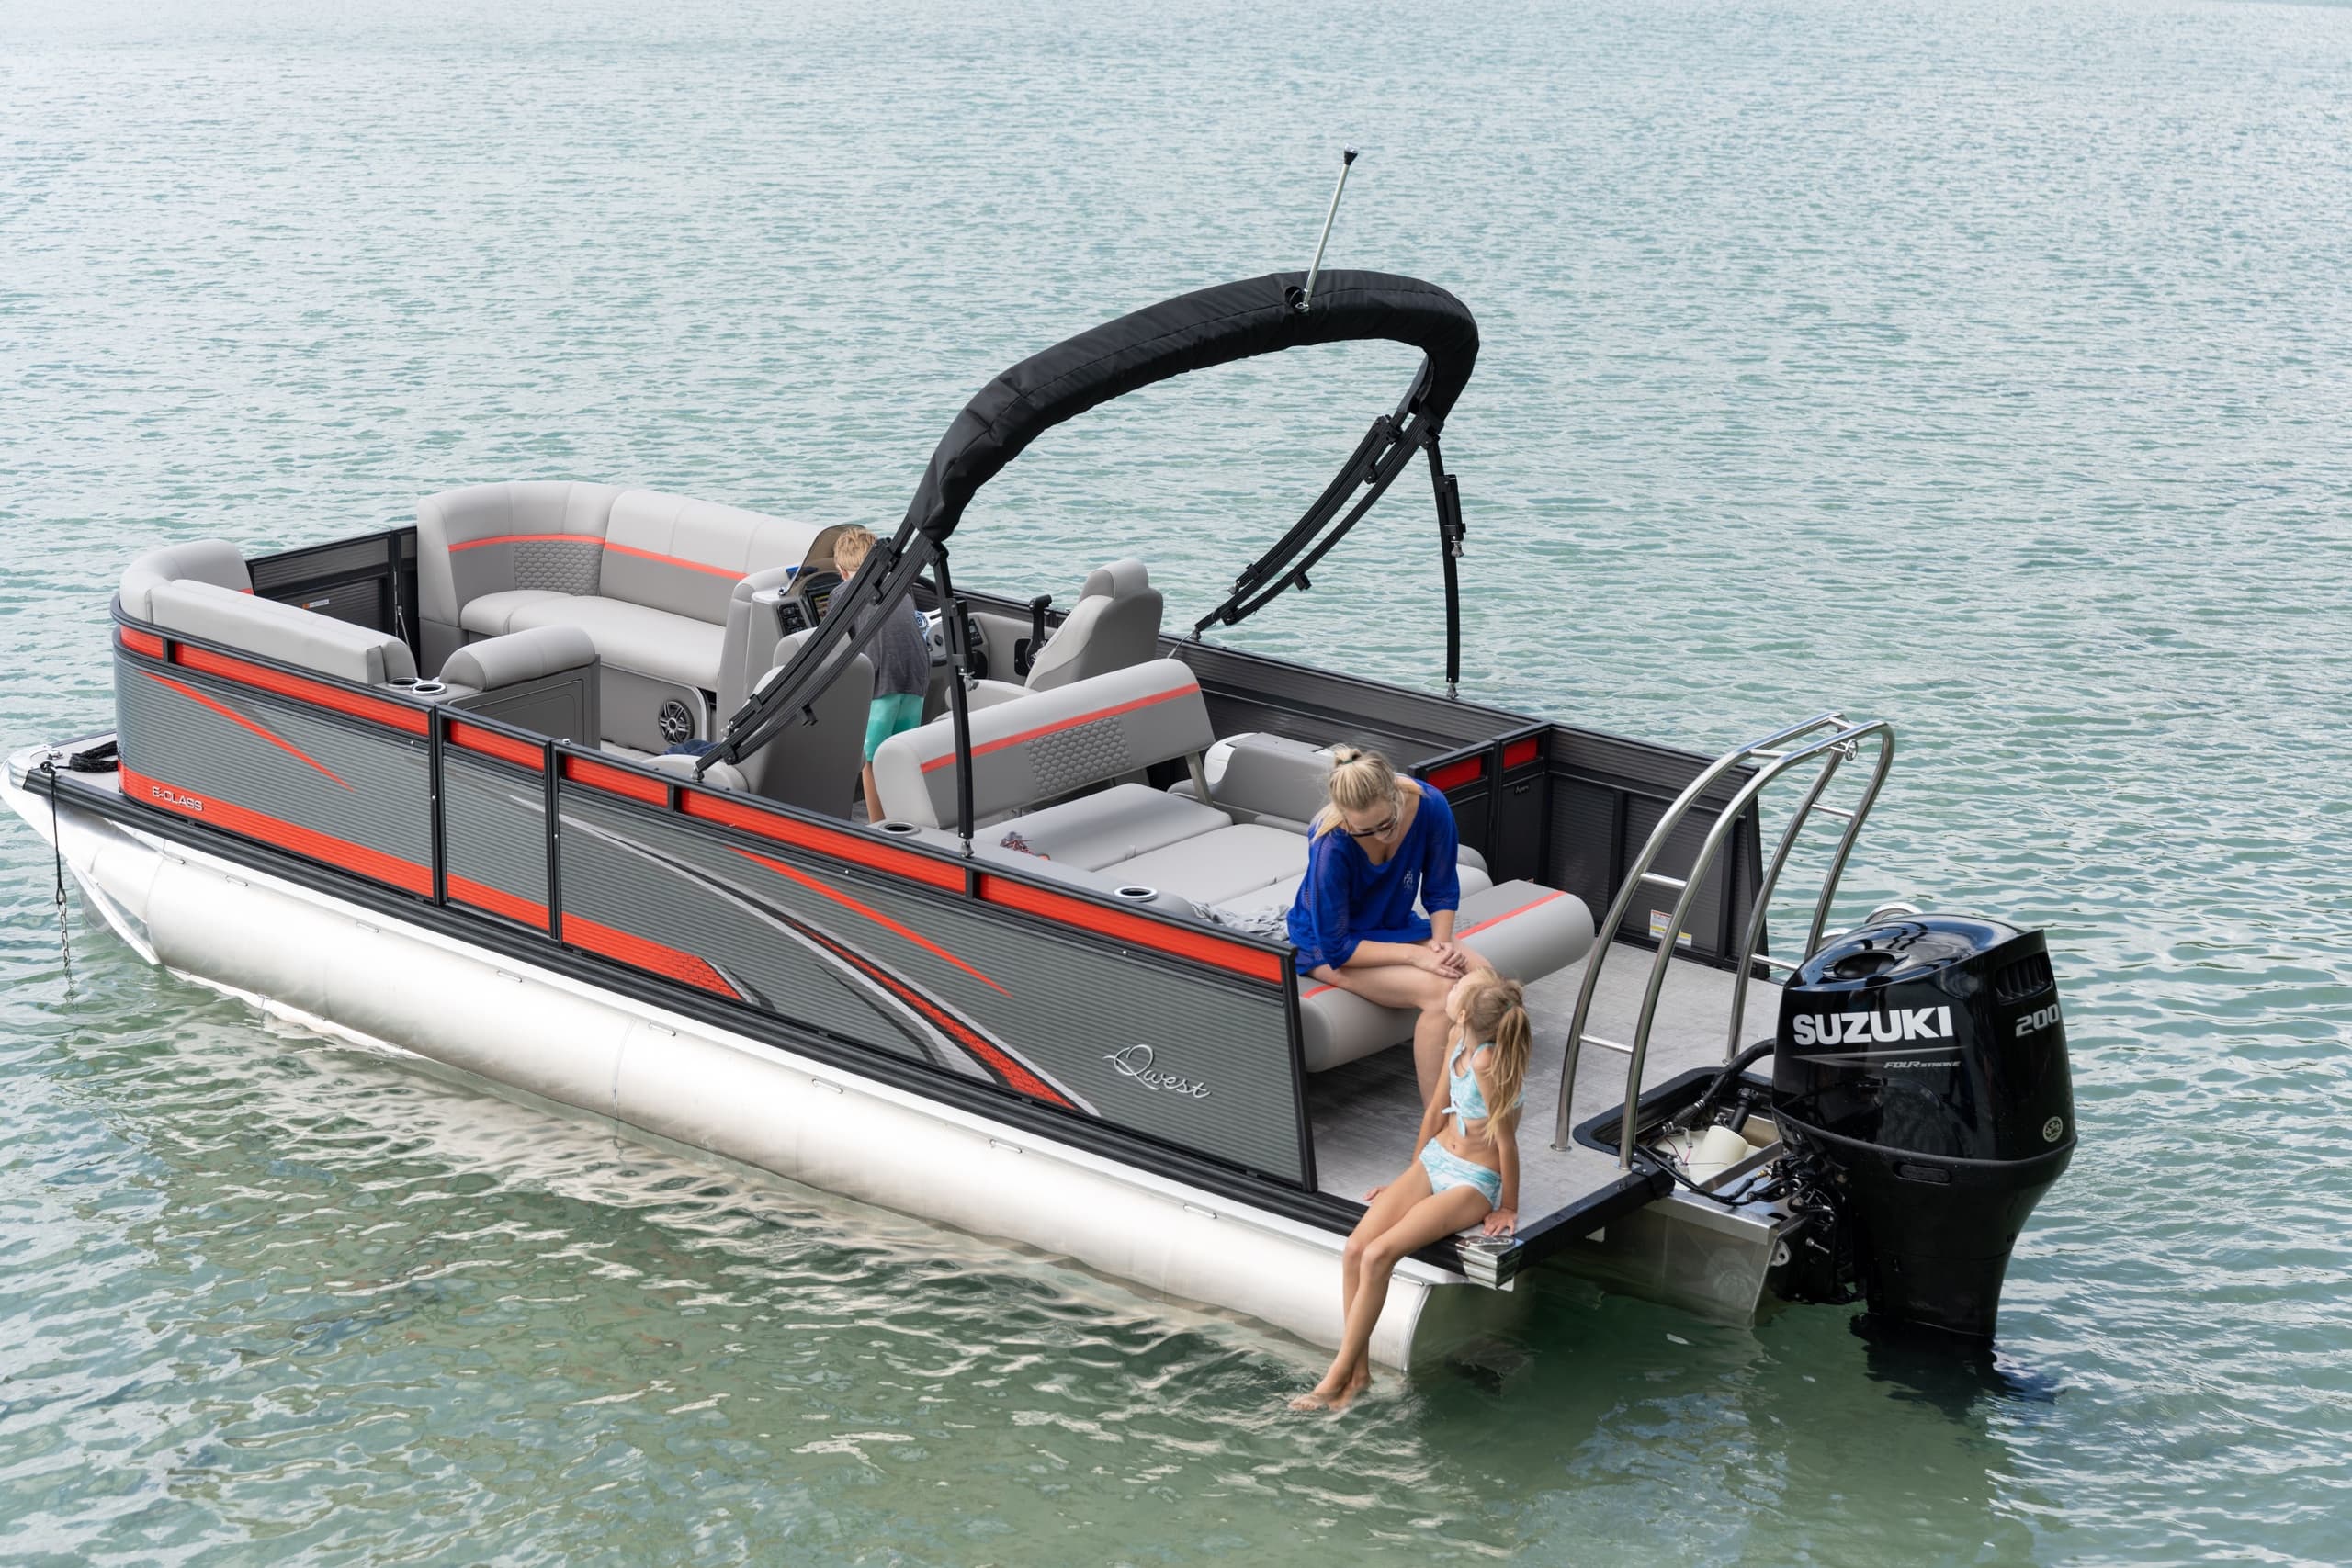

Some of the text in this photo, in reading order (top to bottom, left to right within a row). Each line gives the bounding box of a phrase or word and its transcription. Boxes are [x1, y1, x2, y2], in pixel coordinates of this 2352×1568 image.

[152, 786, 203, 811] E-CLASS
[1792, 1006, 1953, 1045] SUZUKI
[2015, 1003, 2059, 1037] 200
[1102, 1044, 1211, 1098] Qwest
